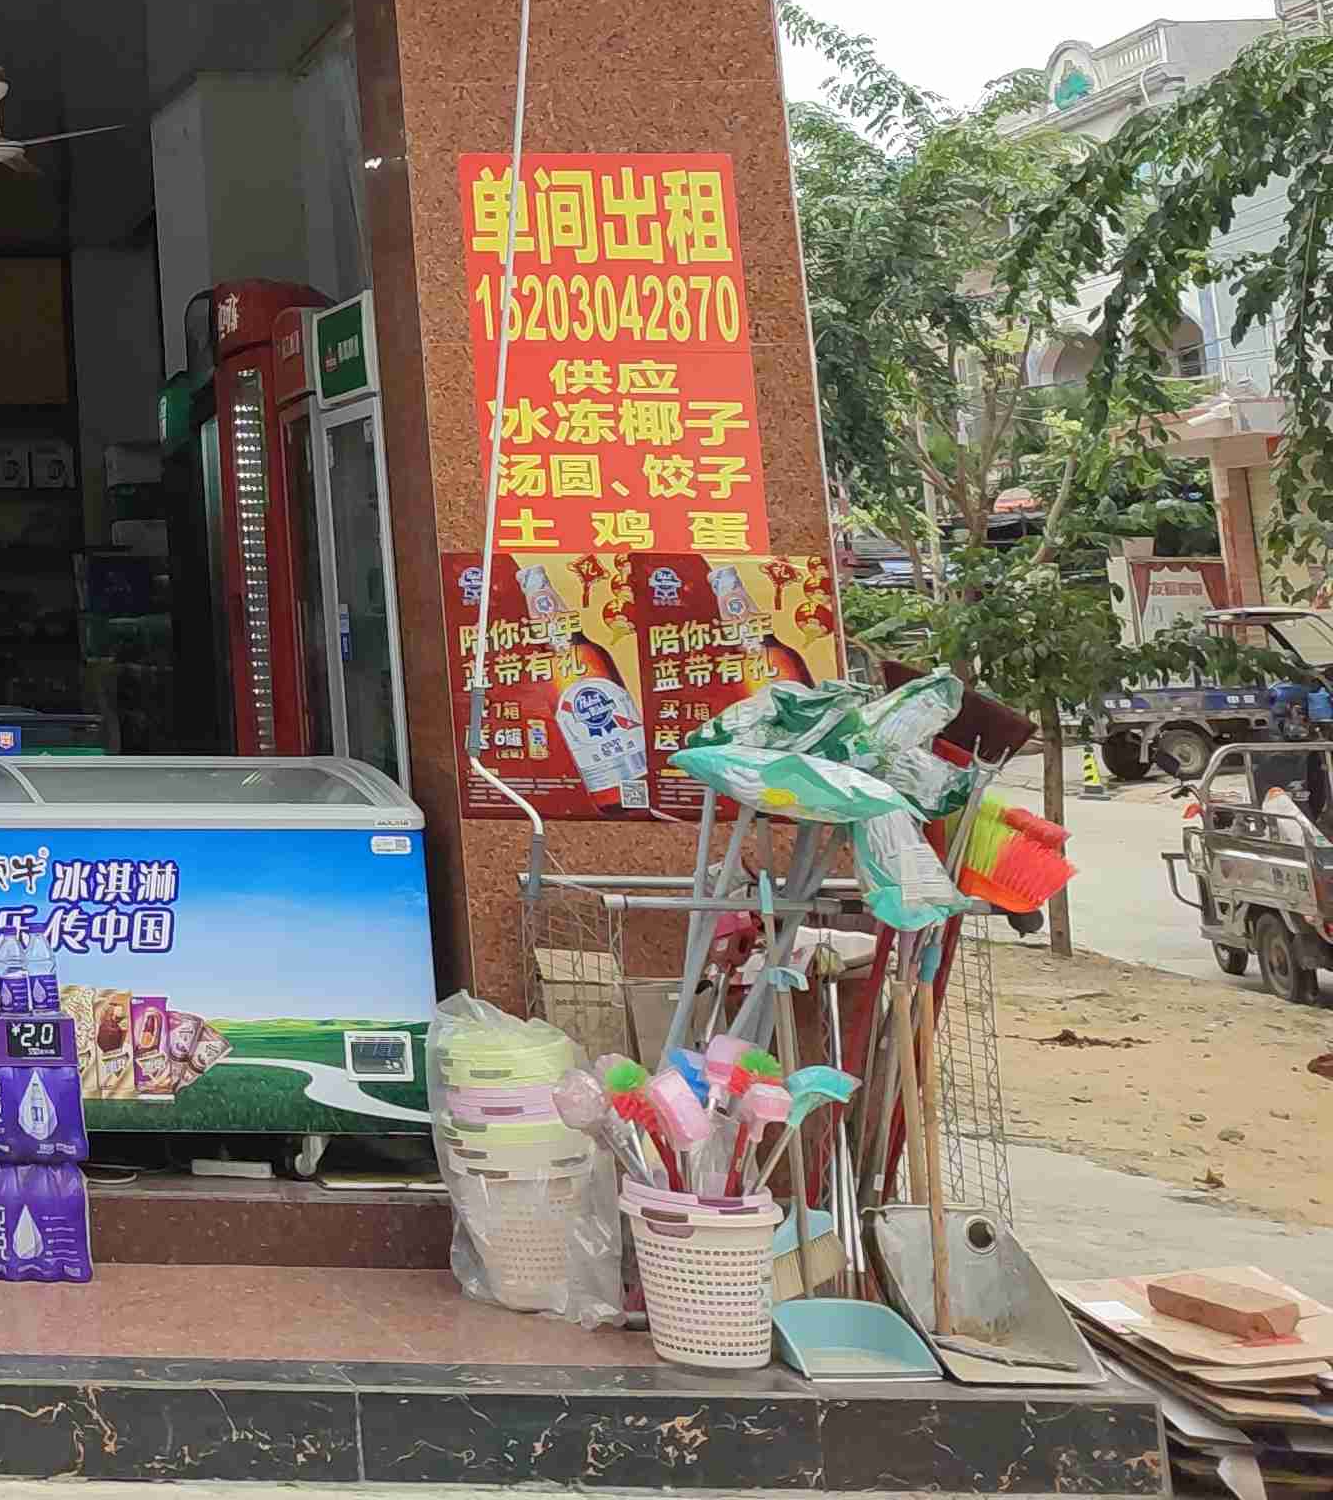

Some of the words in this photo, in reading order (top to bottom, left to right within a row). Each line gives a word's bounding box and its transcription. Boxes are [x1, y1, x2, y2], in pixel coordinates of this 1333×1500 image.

[471, 166, 734, 265] 单间出租
[475, 273, 741, 343] 15203042870
[548, 359, 680, 396] 供应
[488, 398, 750, 447] 冰冻椰子
[649, 611, 774, 657] 陪你过年
[652, 646, 779, 694] 蓝带有礼
[51, 860, 178, 902] 冰淇淋
[11, 1023, 55, 1048] ¥2.0
